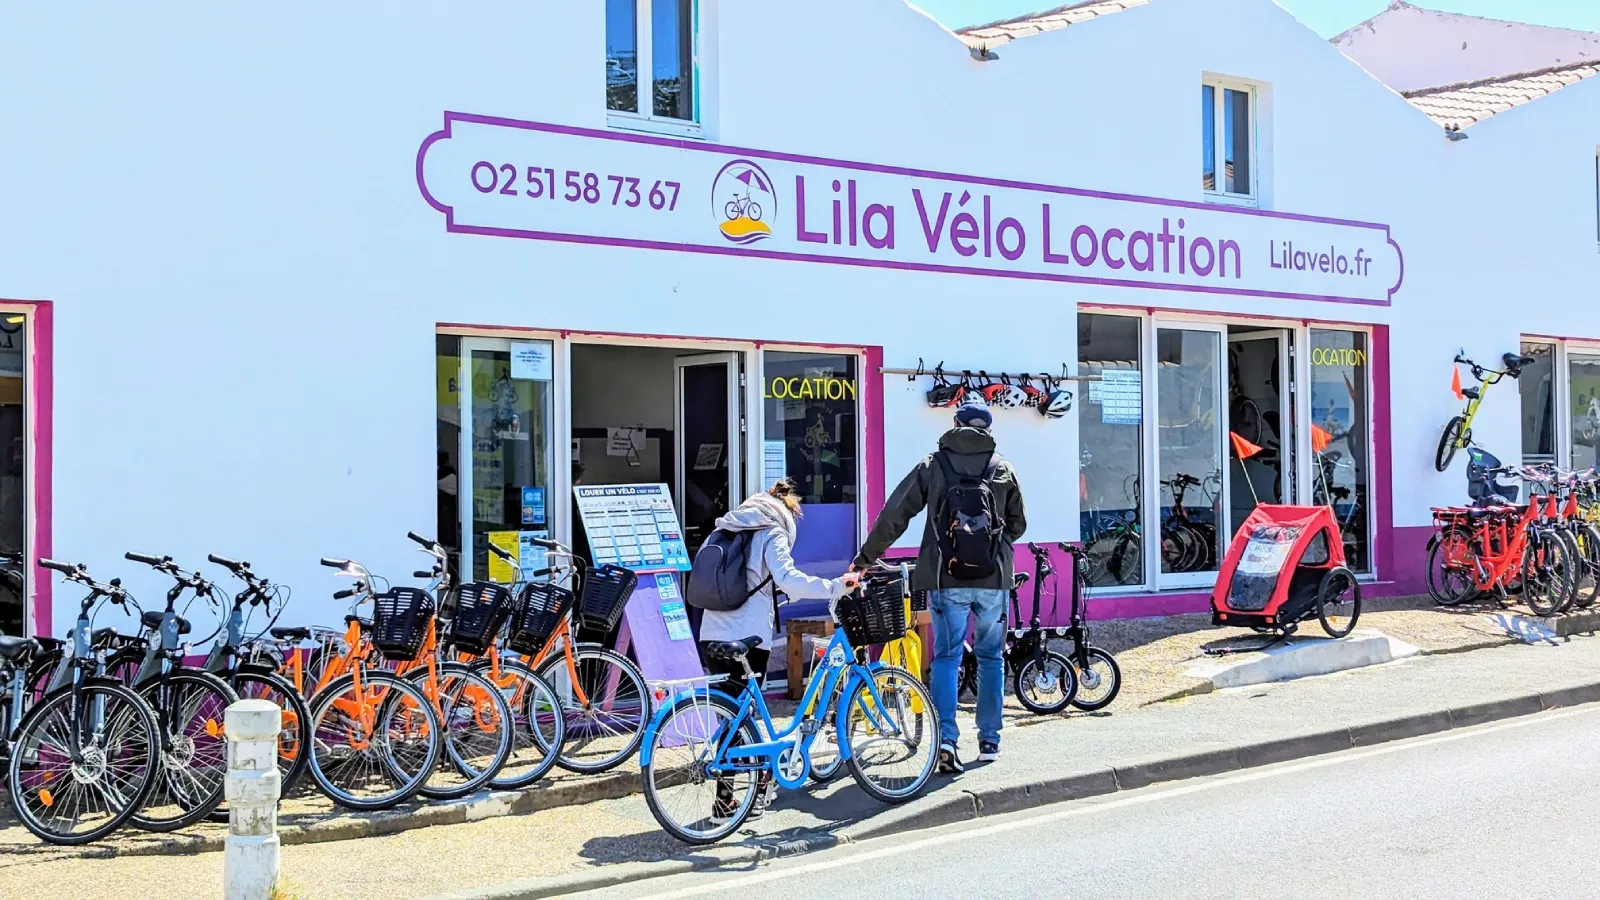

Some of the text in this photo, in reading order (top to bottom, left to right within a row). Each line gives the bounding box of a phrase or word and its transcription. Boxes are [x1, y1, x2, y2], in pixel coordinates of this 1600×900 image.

[471, 160, 681, 212] 02 51 58 73 67
[796, 175, 1242, 279] Lila Vélo Location
[1270, 239, 1373, 277] Lilavelo.fr
[763, 376, 856, 400] LOCATION
[580, 488, 605, 497] LOUER
[605, 488, 616, 496] UN
[617, 486, 636, 496] VÉLO
